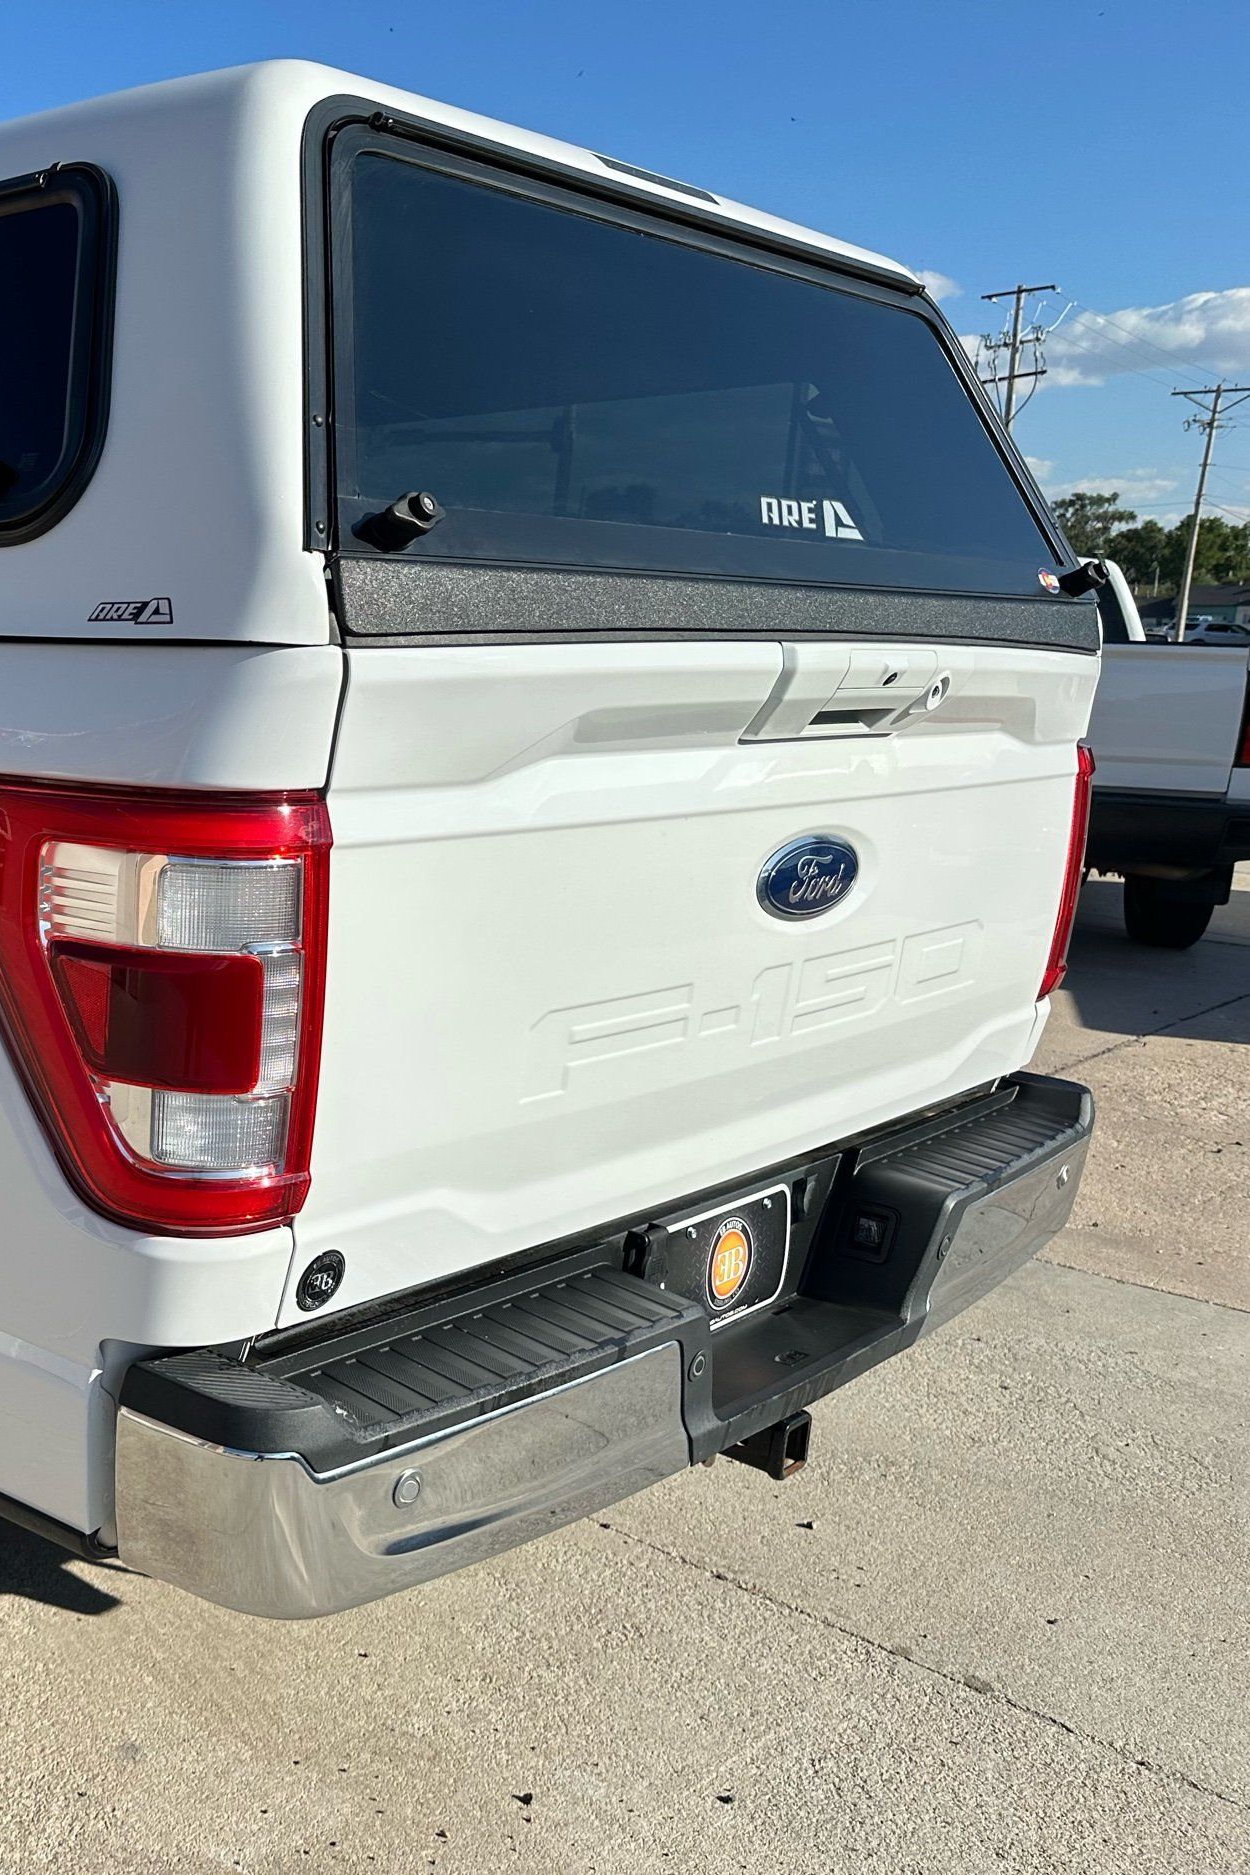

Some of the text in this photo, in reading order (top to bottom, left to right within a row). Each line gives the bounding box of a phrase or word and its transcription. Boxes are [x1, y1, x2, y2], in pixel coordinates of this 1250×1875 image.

[760, 495, 817, 529] ARE
[788, 854, 846, 904] Ford
[518, 918, 985, 1104] F-150
